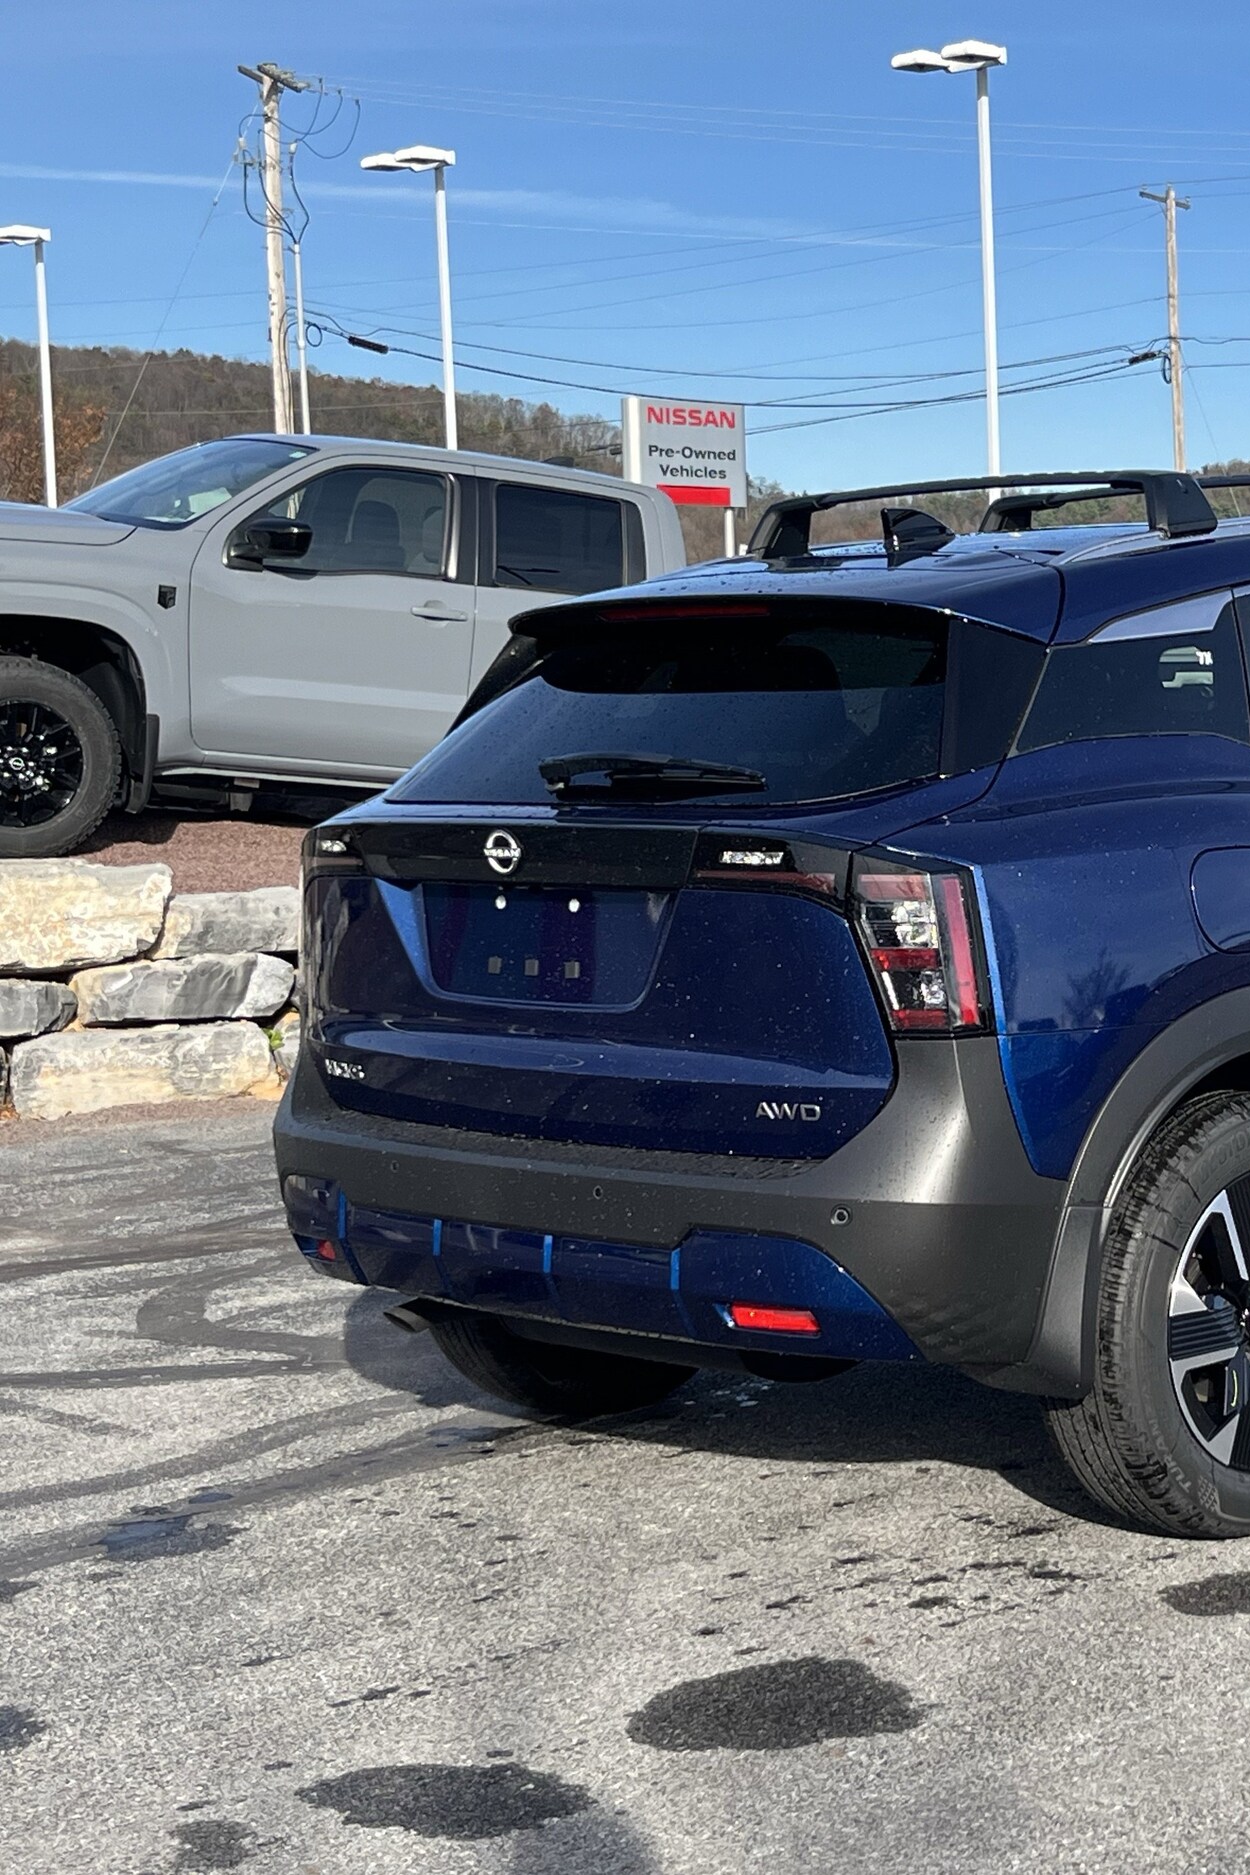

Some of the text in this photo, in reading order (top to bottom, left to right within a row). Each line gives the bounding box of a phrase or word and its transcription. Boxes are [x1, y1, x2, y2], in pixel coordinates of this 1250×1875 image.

[647, 406, 736, 429] NISSAN
[648, 445, 736, 461] Pre-Owned
[659, 464, 727, 479] Vehicles
[755, 1101, 821, 1121] AWD
